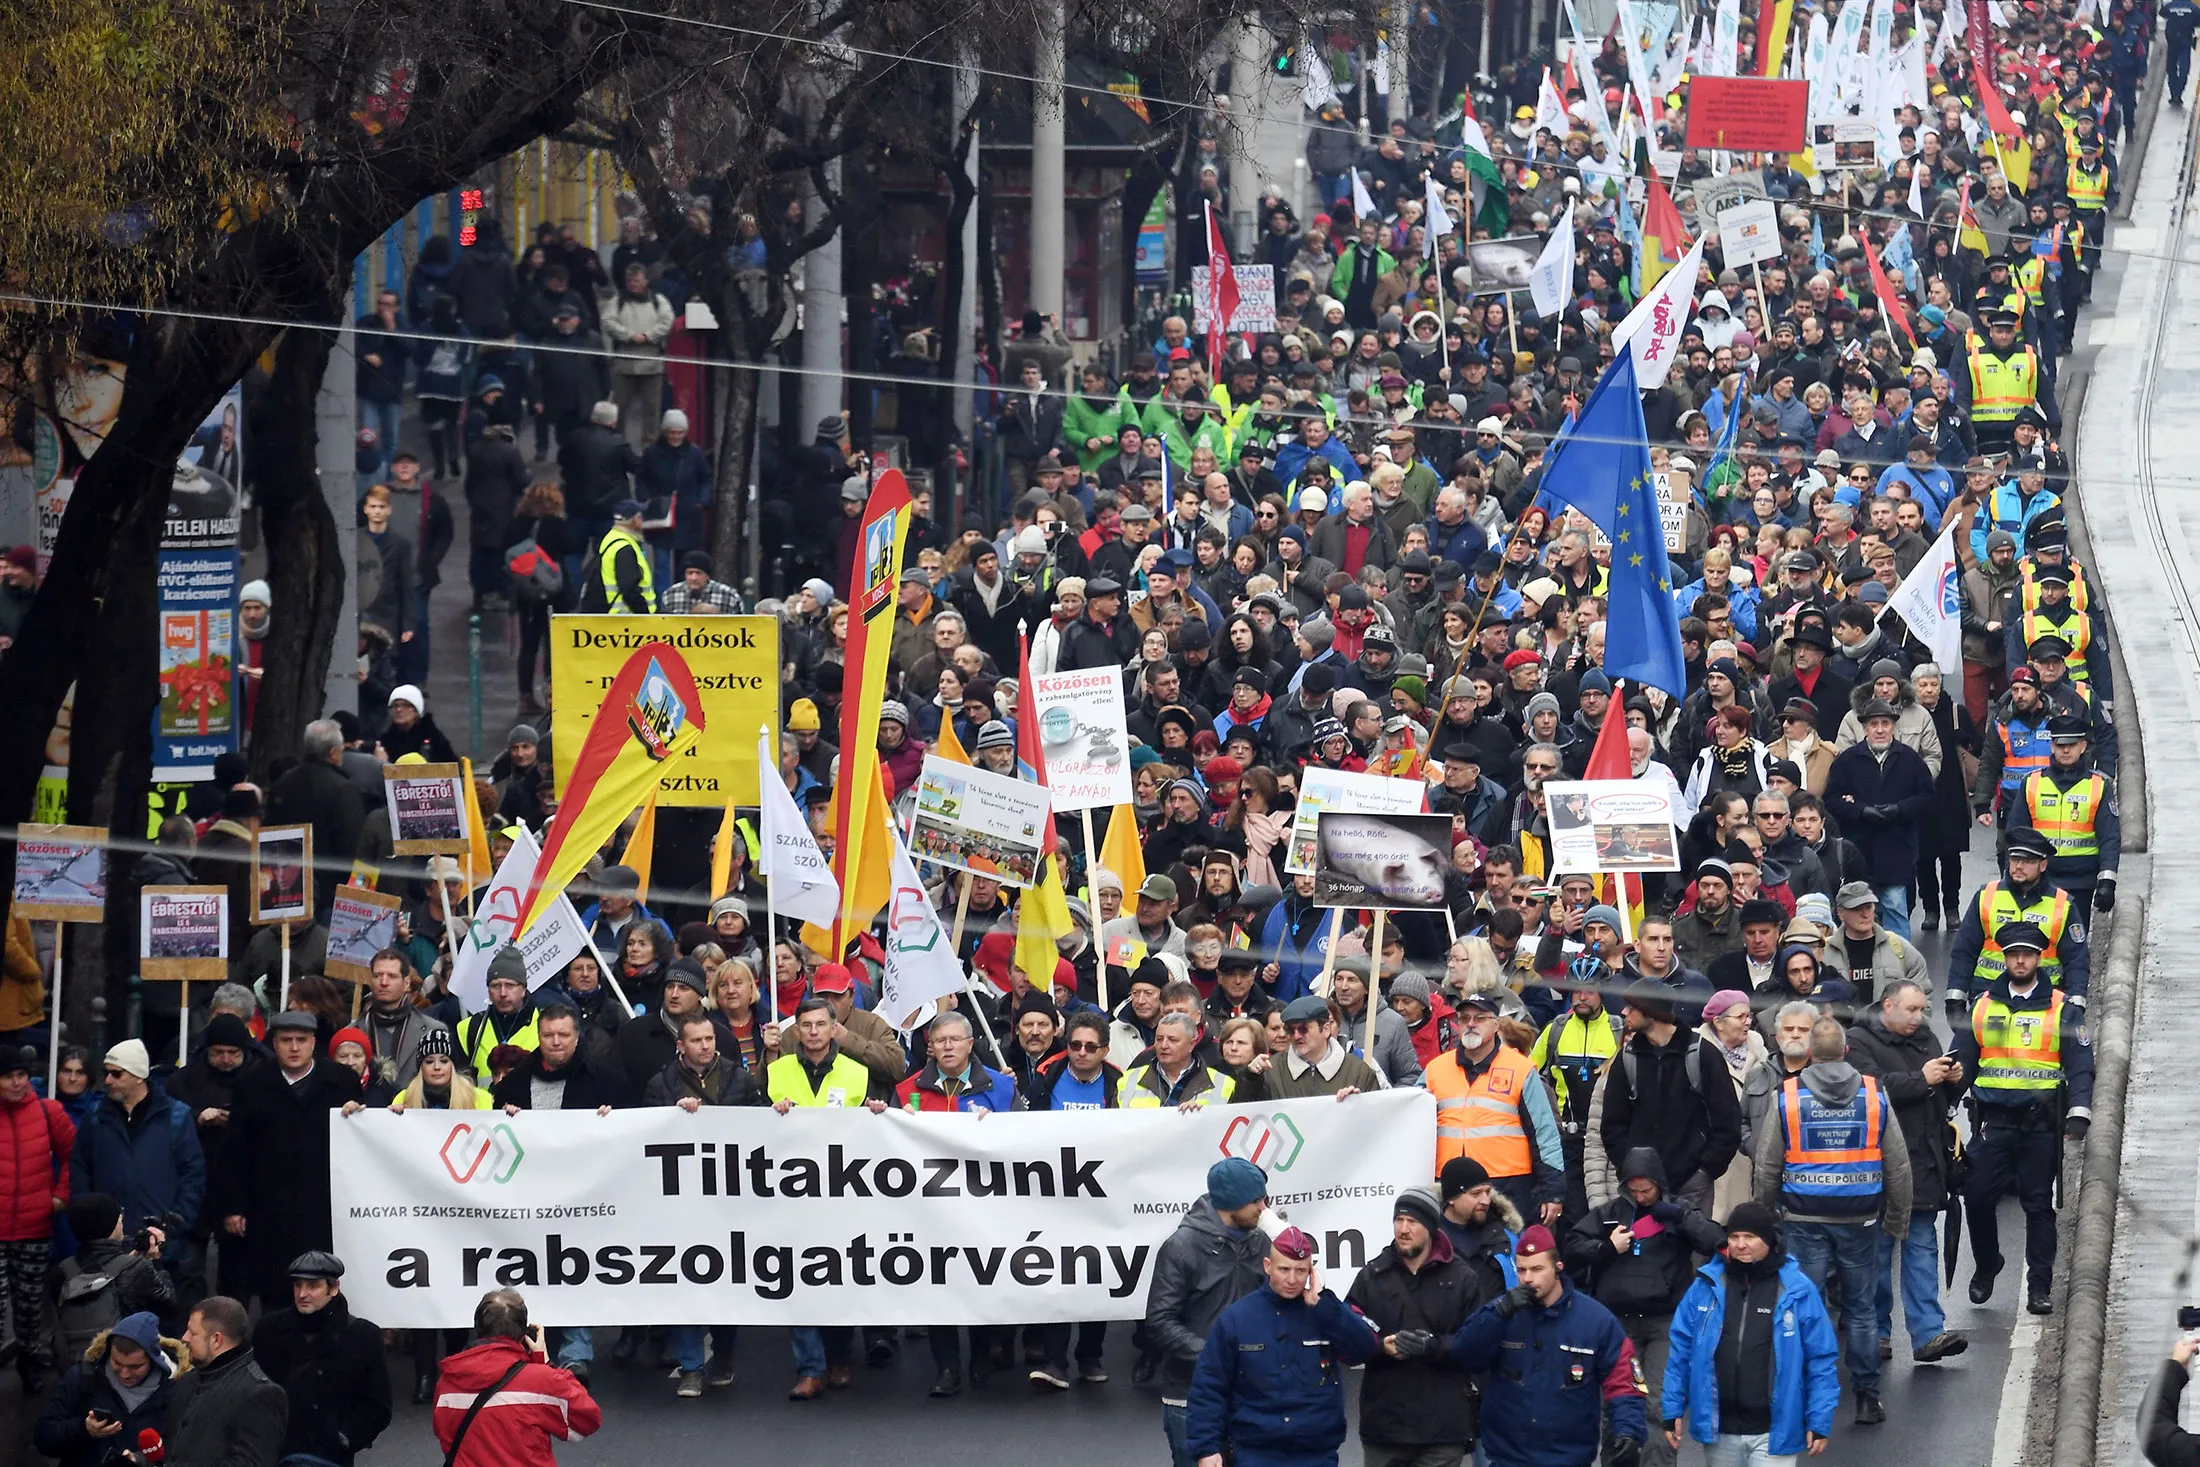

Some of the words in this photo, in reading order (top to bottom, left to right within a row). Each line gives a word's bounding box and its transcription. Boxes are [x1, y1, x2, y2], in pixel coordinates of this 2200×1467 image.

[1662, 521, 1680, 531] OM
[168, 623, 194, 640] hvg
[572, 627, 756, 649] Devizaadósok
[695, 676, 763, 690] esztve
[659, 776, 720, 791] sztva
[1328, 884, 1338, 892] 36
[1340, 883, 1365, 894] hónap
[151, 900, 217, 917] ÉBRESZTŐ!
[2008, 1069, 2044, 1079] POLICE
[1811, 1109, 1856, 1118] CSOPORT
[1824, 1138, 1846, 1146] TEAM
[644, 1142, 1108, 1198] Tiltakozunk
[1794, 1174, 1833, 1184] POLICE
[1835, 1174, 1868, 1184] POLICE
[1133, 1202, 1191, 1215] MAGYAR
[1266, 1192, 1313, 1207] VEZETI
[1317, 1182, 1395, 1201] SZÖVETSÉG
[349, 1206, 408, 1219] MAGYAR
[412, 1205, 531, 1220] SZAKSZERVEZETI
[536, 1202, 617, 1219] SZÖVETSÉG
[386, 1247, 431, 1289] a
[462, 1230, 1151, 1300] rabszolgatörvény
